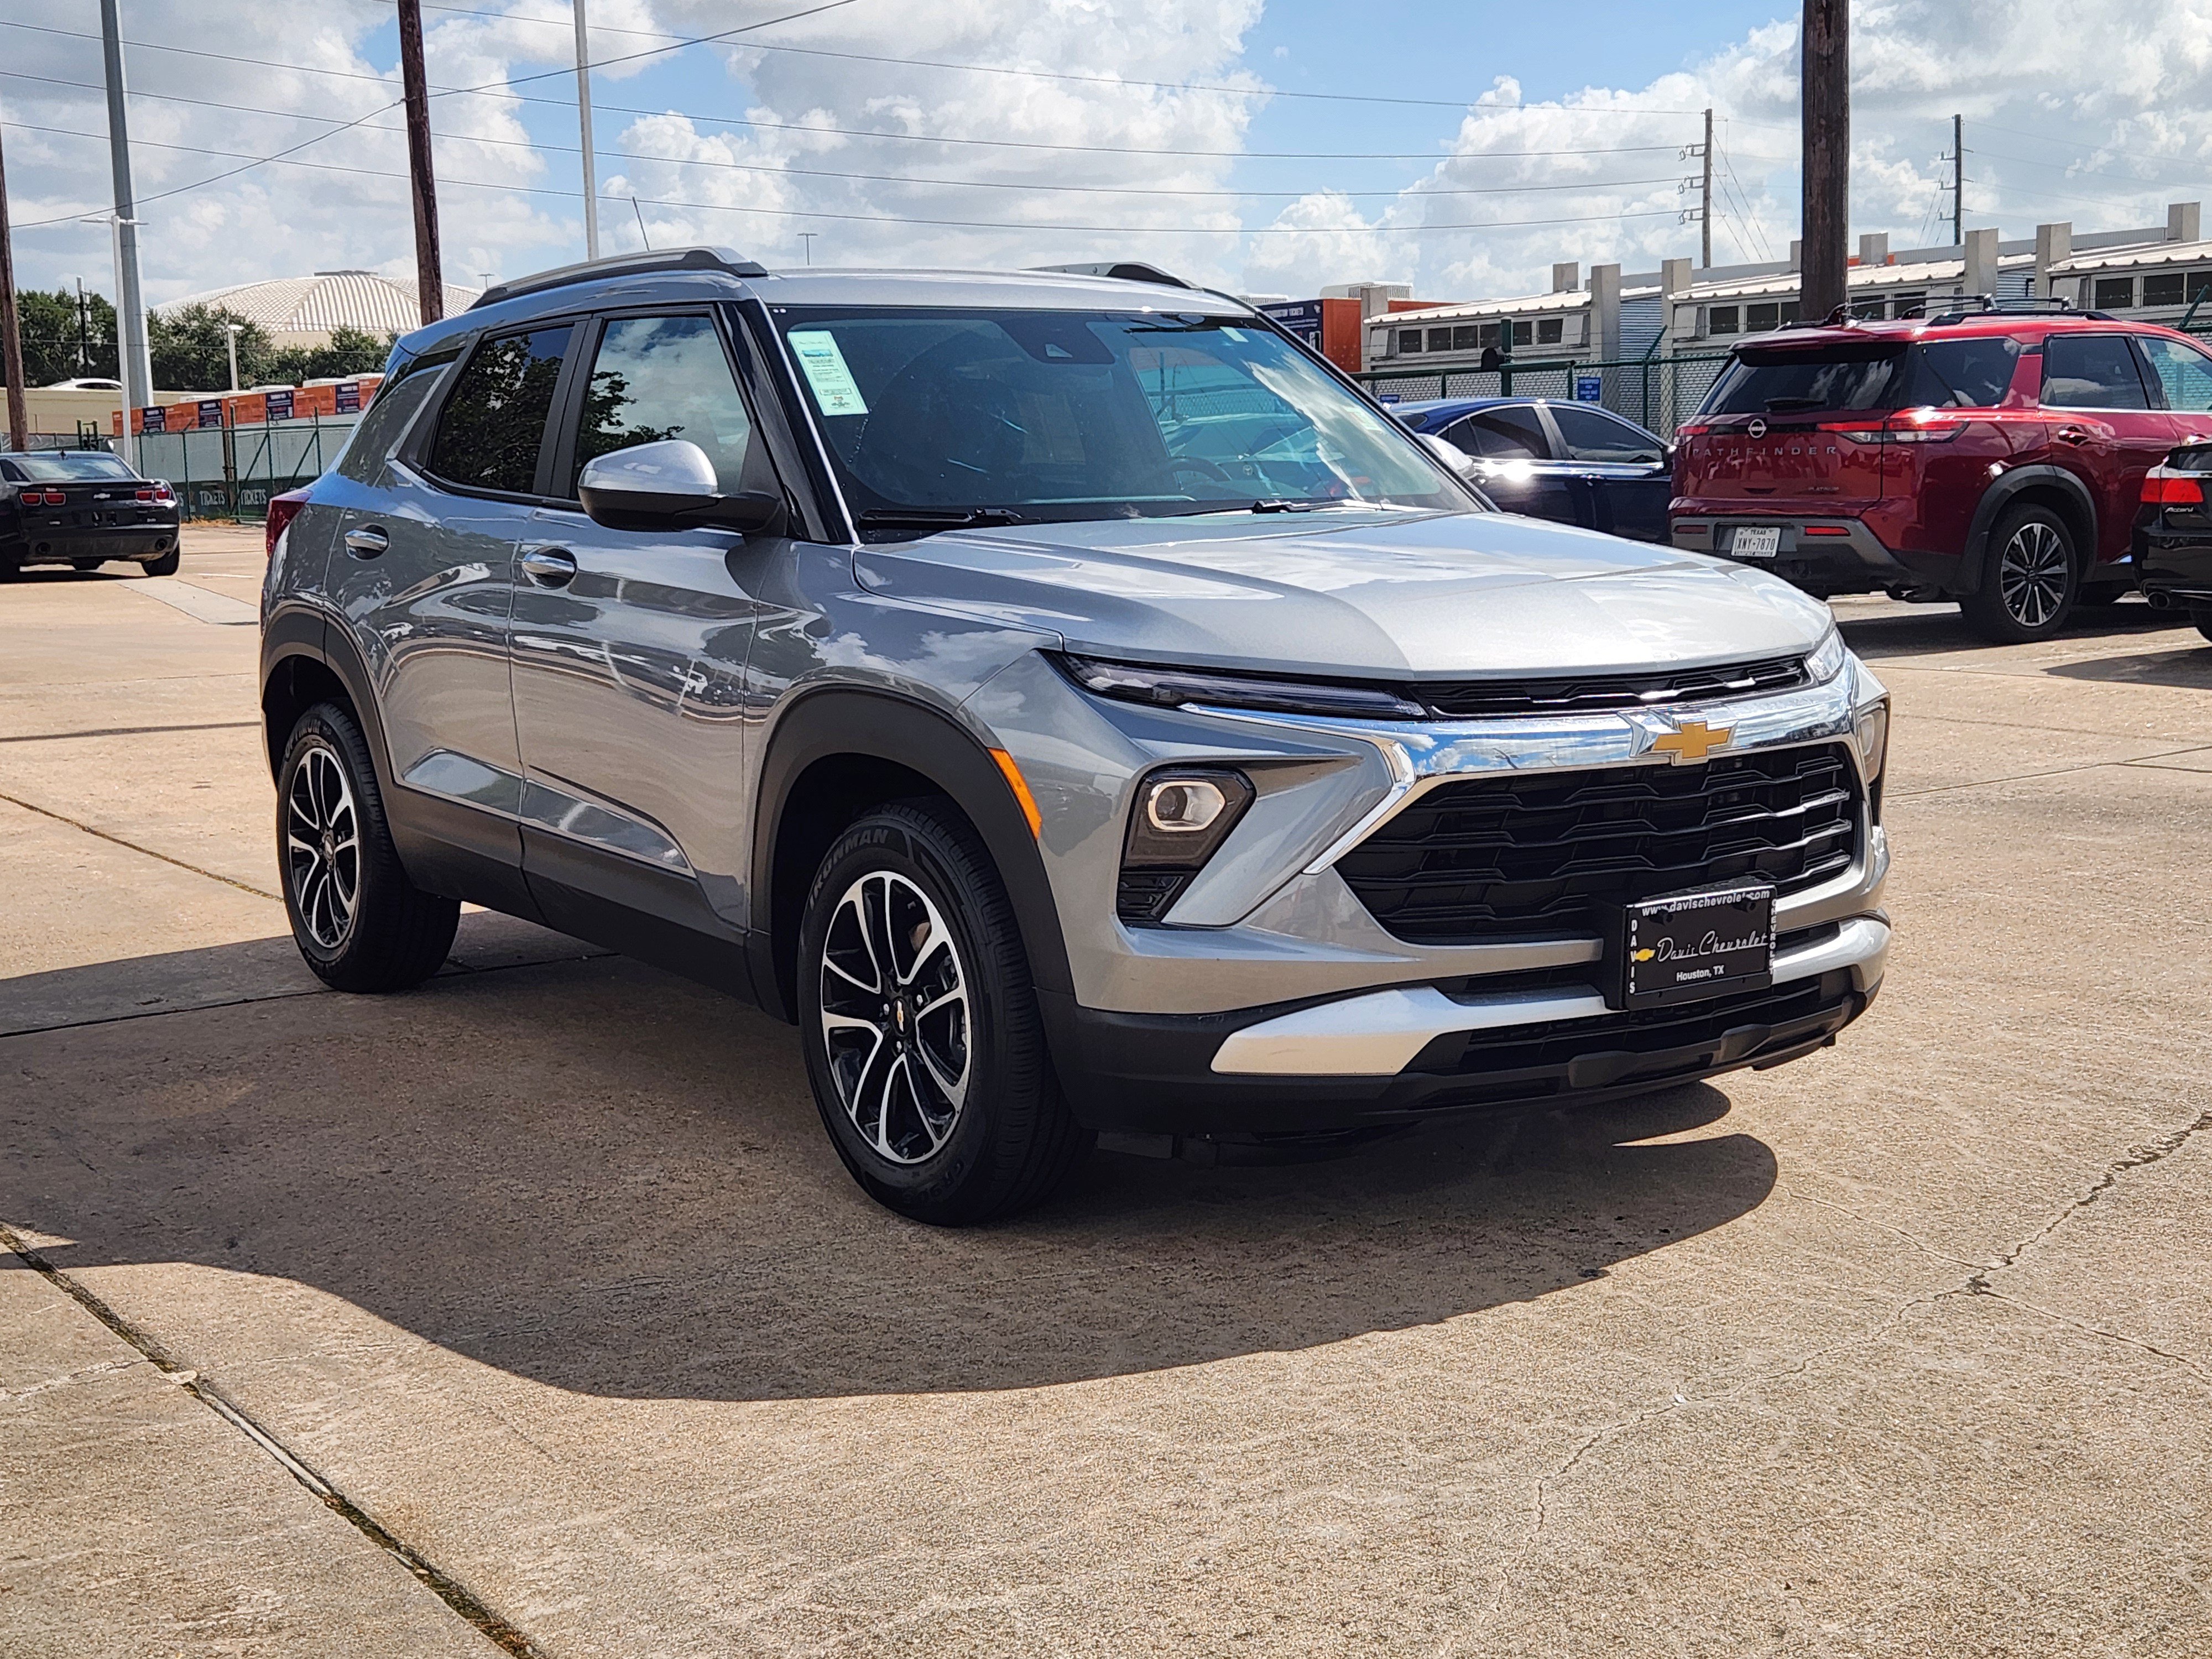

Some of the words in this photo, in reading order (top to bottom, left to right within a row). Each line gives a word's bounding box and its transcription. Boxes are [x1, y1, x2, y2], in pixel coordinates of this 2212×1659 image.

[1692, 446, 1837, 457] PATHFINDER
[809, 828, 889, 911] IRONMAN
[1642, 890, 1770, 916] wwwdavischevroletcom
[1629, 919, 1637, 994] DAVIS
[1657, 937, 1699, 962] Davis
[1699, 930, 1768, 955] Chevrolet
[1676, 969, 1712, 982] Houston,
[1713, 964, 1725, 975] TX
